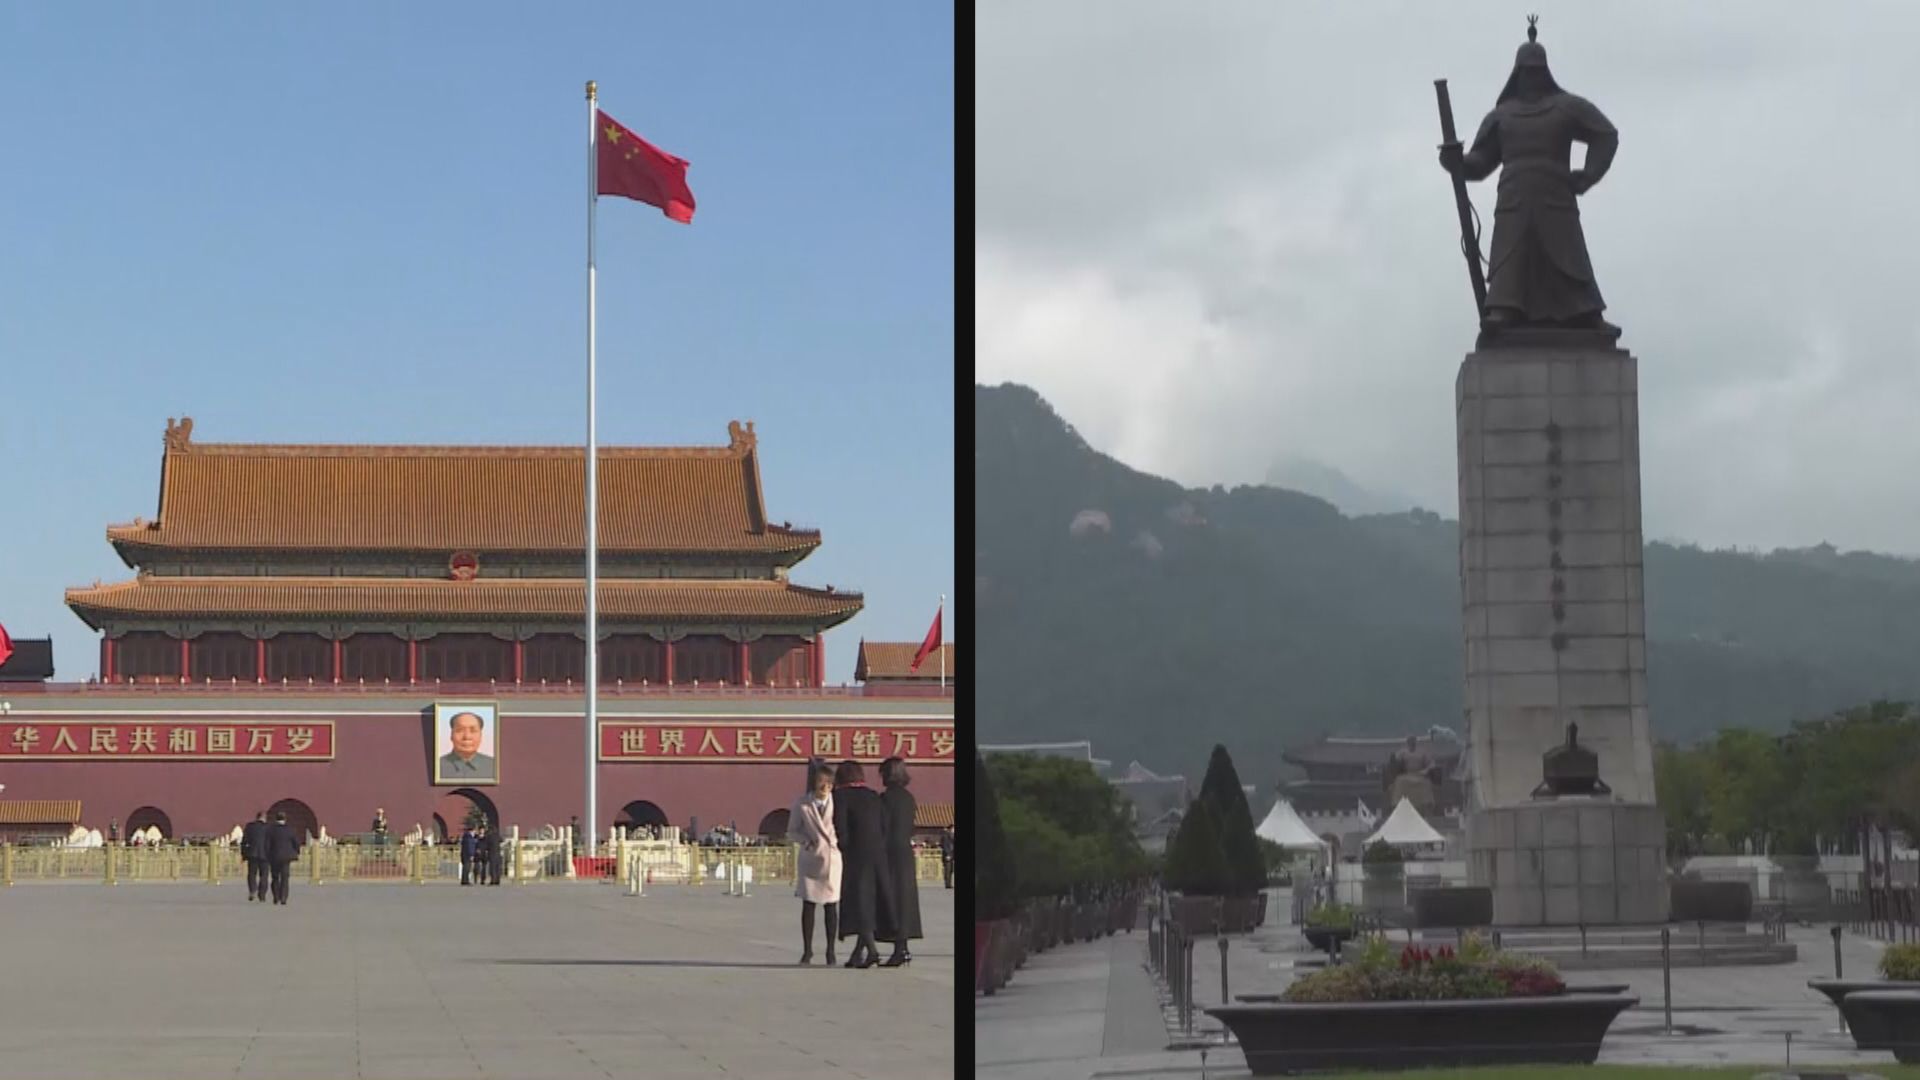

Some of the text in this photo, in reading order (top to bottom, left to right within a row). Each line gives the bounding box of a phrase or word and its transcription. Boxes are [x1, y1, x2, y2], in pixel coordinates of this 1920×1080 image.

[12, 726, 315, 753] 华人民共和国万岁
[620, 729, 954, 756] 世界人民大团结万岁
